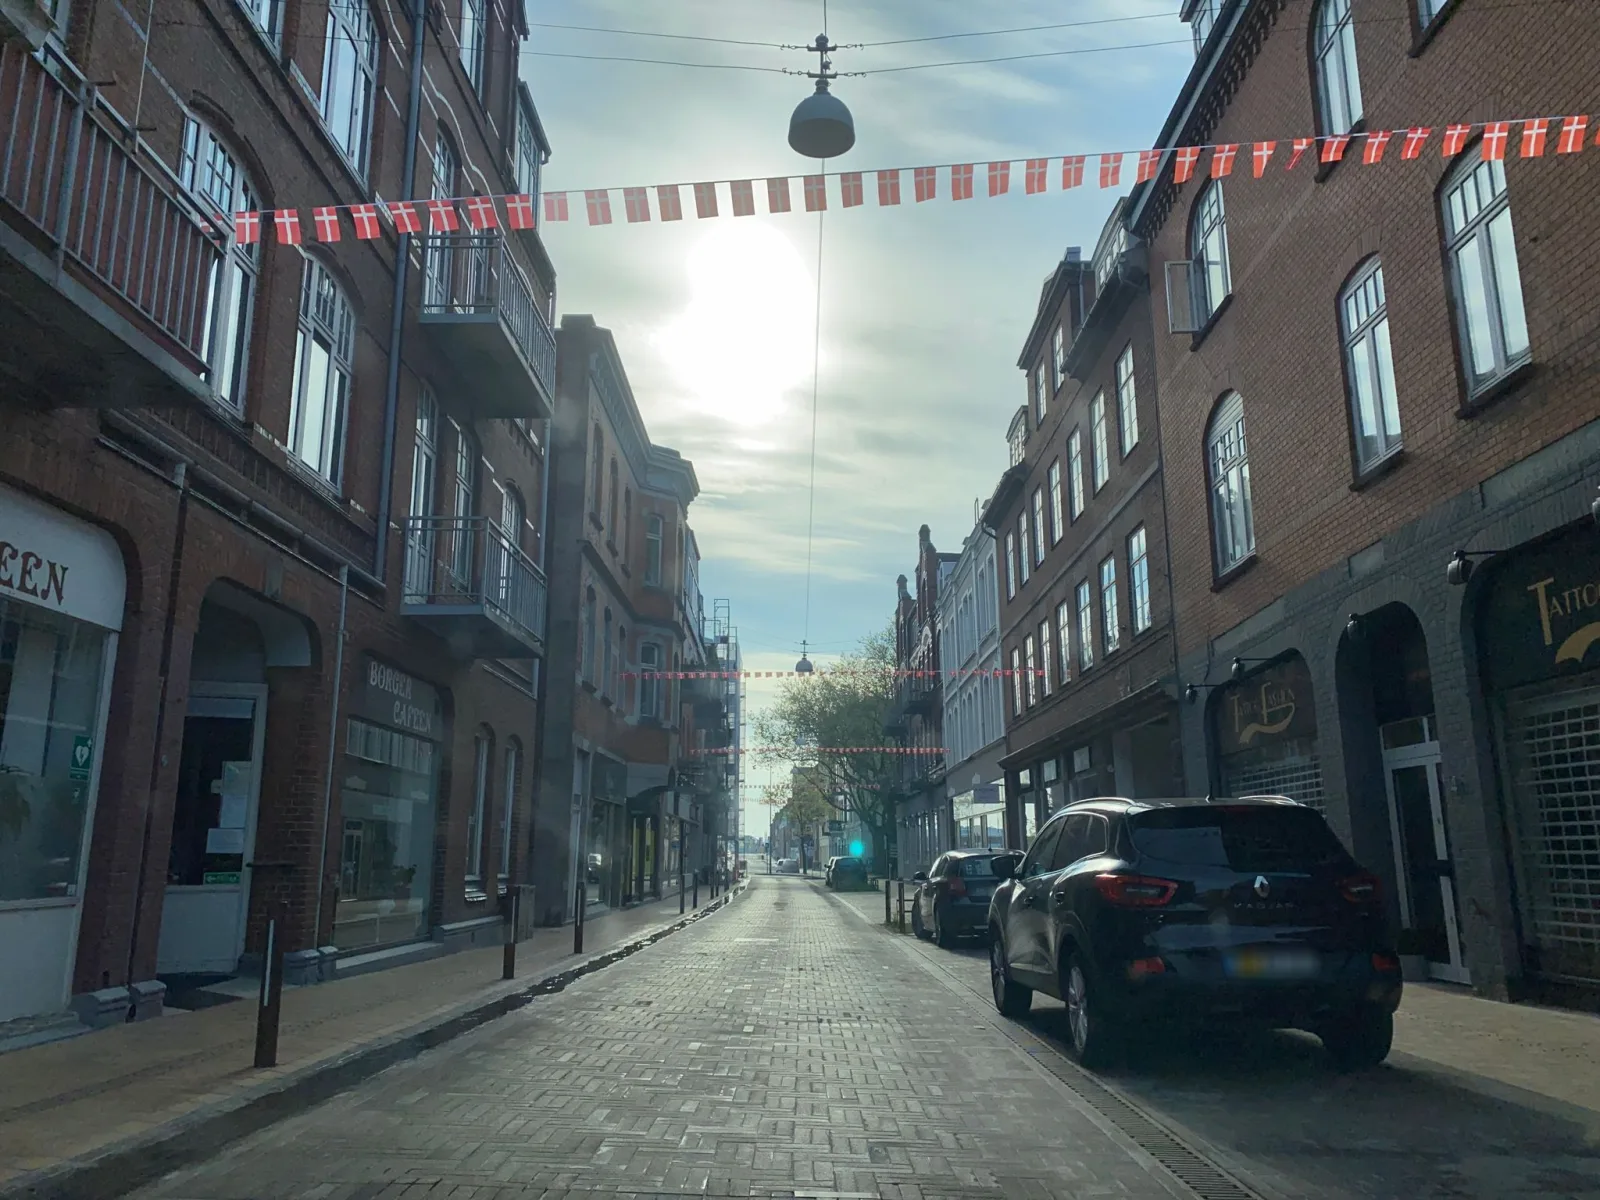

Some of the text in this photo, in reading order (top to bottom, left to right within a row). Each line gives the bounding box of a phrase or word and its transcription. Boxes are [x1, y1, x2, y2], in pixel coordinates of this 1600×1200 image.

[0, 541, 69, 606] EEN
[1527, 577, 1600, 646] TATTO
[369, 660, 412, 700] BORGER
